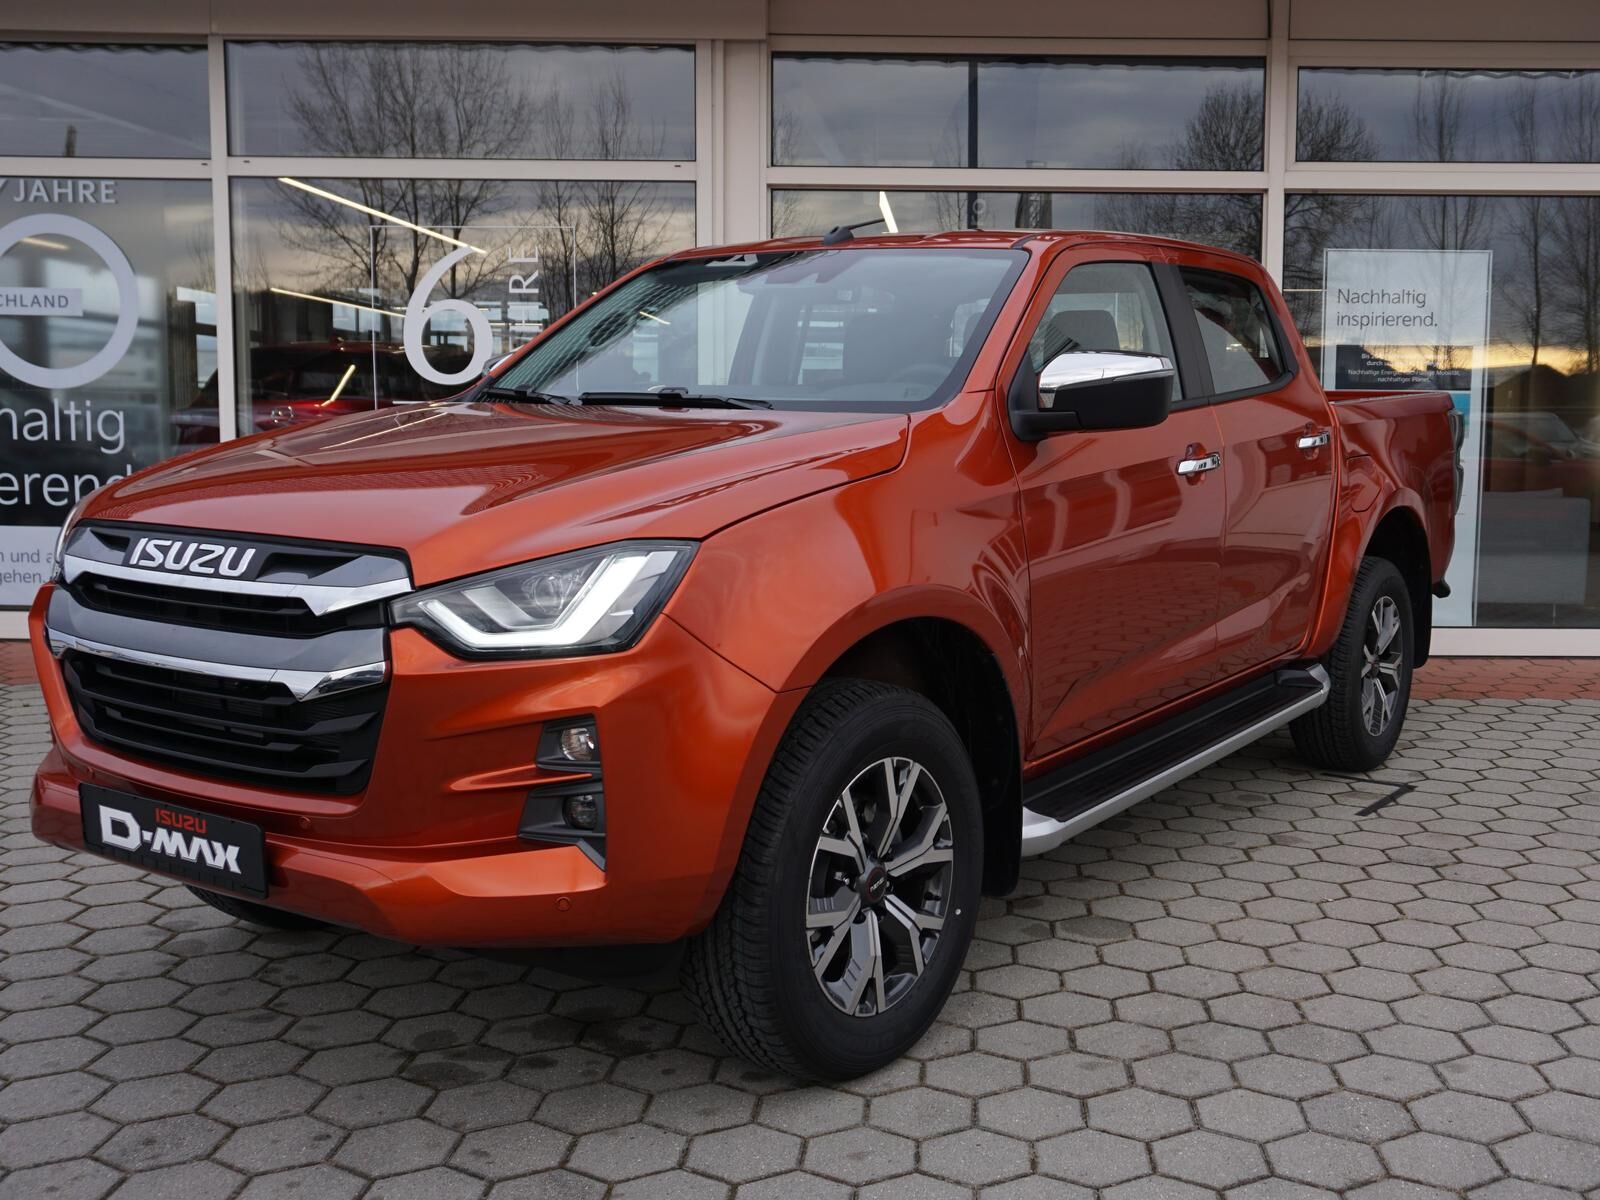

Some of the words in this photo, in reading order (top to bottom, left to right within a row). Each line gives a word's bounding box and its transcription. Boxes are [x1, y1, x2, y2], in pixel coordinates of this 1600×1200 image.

[13, 179, 117, 204] JAHRE
[1337, 288, 1427, 308] Nachhaltig
[1336, 311, 1438, 330] inspirierend.
[10, 549, 40, 563] und
[129, 537, 256, 577] ISUZU
[0, 569, 46, 586] ehen.
[155, 808, 208, 834] ISUZU
[98, 804, 242, 875] D-MAX
